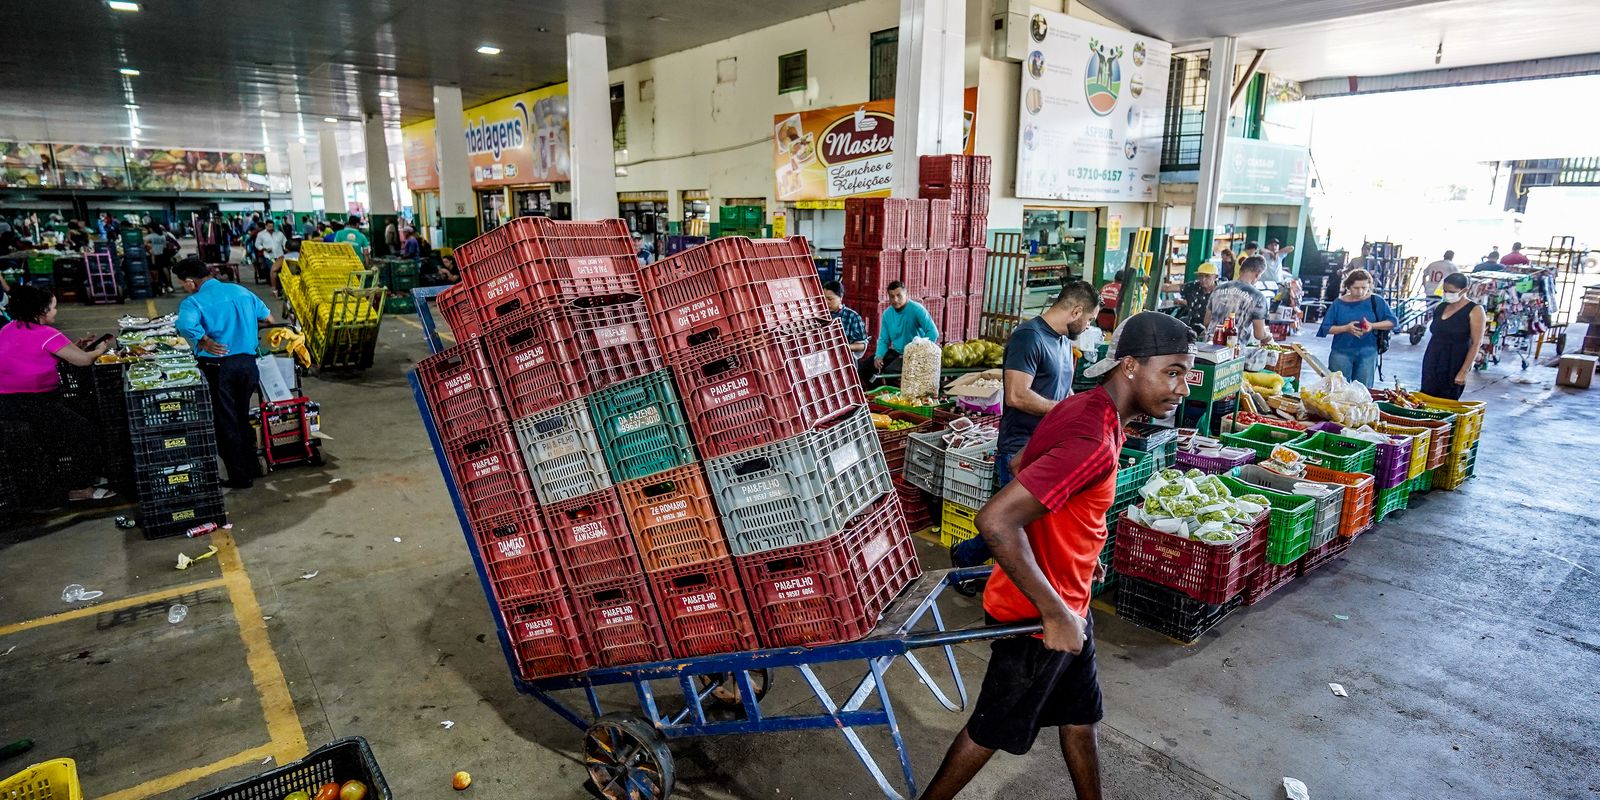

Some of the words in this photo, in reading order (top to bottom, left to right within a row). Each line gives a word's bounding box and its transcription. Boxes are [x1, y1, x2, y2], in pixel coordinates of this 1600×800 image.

[826, 133, 894, 156] Master
[831, 162, 881, 180] Lanches
[1077, 167, 1122, 181] 3710-6157
[833, 175, 892, 194] Refeições
[1430, 270, 1443, 282] 10
[502, 282, 509, 291] &
[508, 278, 519, 289] PAI
[486, 286, 503, 299] FILHO
[699, 309, 707, 318] &
[706, 305, 719, 316] PAI
[677, 311, 700, 326] FILHO
[514, 346, 544, 364] PAI&FILHO
[444, 373, 471, 389] PAI&FILHO
[709, 377, 749, 396] PAI&FILHO
[617, 415, 628, 425] DA
[628, 405, 658, 421] FAZENDA
[620, 413, 661, 433] 99637-3010
[556, 433, 574, 445] FILHO
[471, 456, 499, 470] PAI&FILHO
[741, 479, 780, 495] PAI&FILHO
[659, 499, 687, 513] ROMARIO
[572, 521, 598, 535] ERNESTO
[574, 526, 607, 542] KAWASHIMA
[497, 536, 525, 553] DAMIÃO
[774, 577, 813, 591] PAI&FILHO
[682, 592, 716, 606] PAI&FILHO
[602, 605, 632, 619] PAI&FILHO
[525, 618, 552, 630] PAI&FILHO
